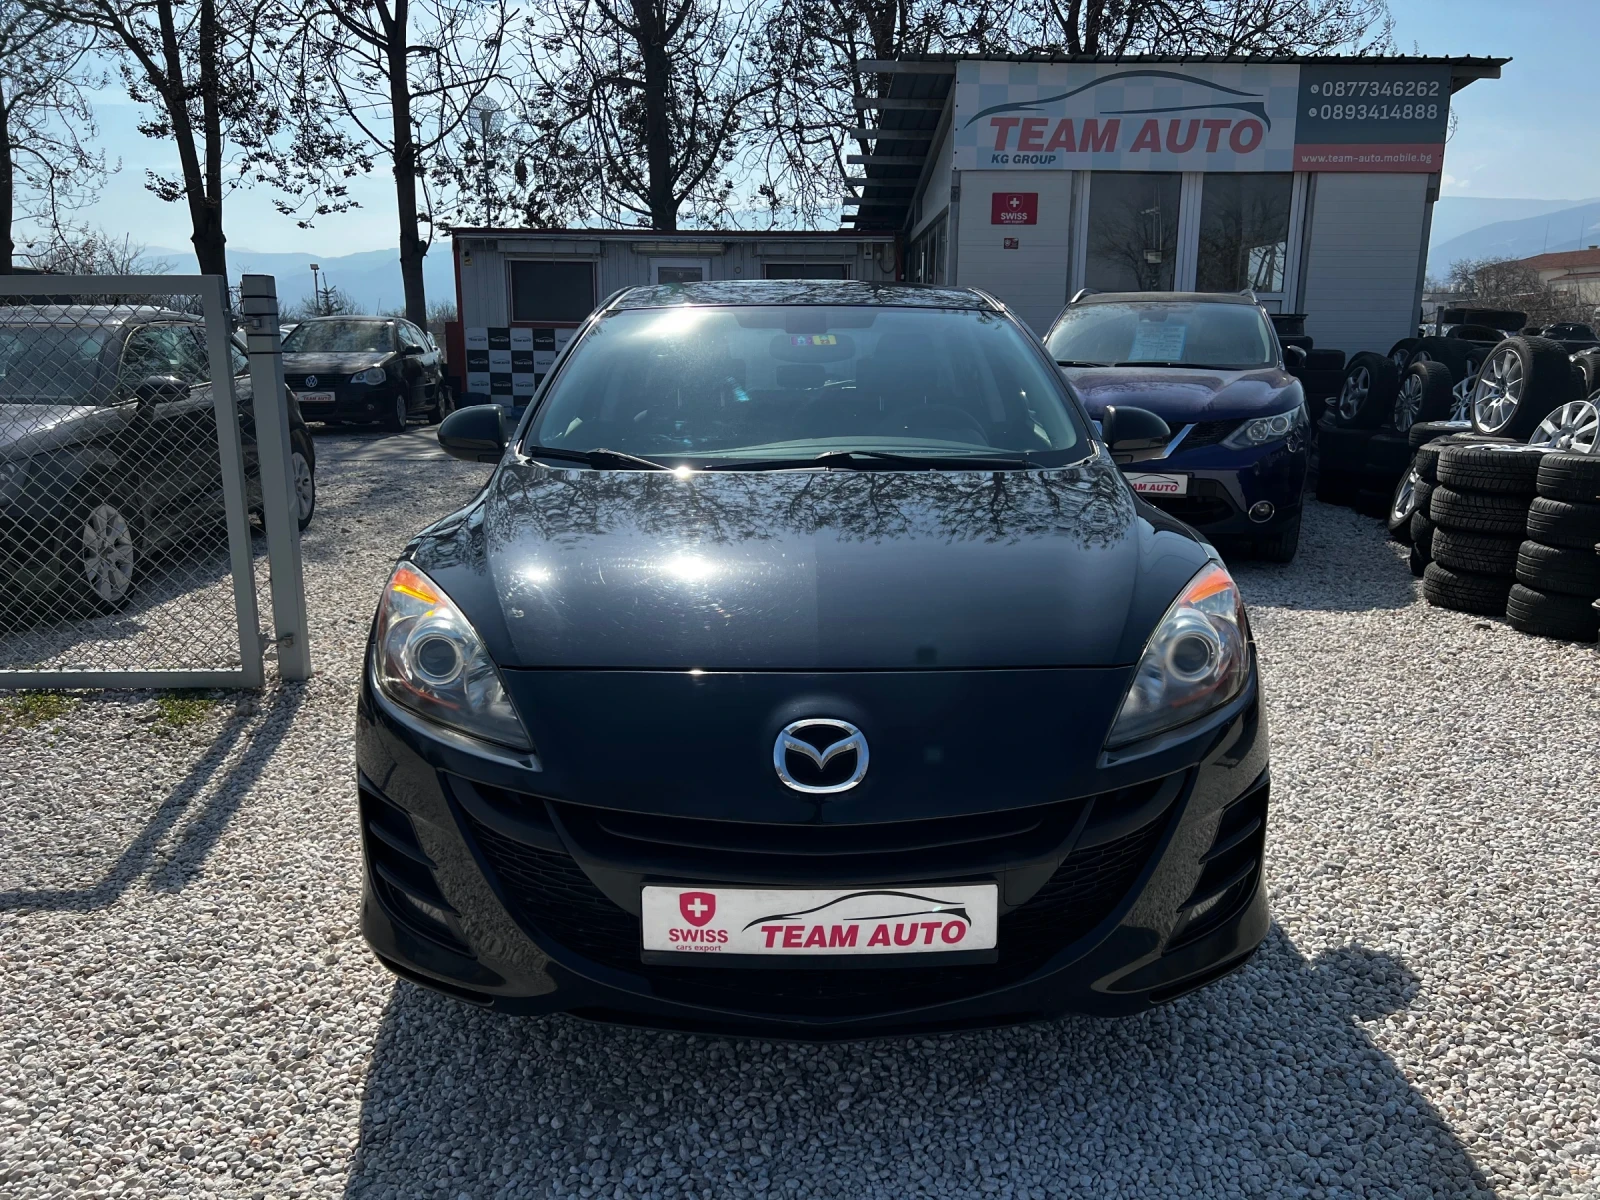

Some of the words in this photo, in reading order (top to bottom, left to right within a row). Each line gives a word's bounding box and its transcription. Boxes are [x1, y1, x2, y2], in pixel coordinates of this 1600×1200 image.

[1322, 81, 1440, 97] 0877346262
[1320, 104, 1438, 120] 0893414888
[989, 117, 1121, 153] TEAM
[1129, 117, 1264, 154] AUTO
[991, 153, 1010, 164] KG
[1012, 154, 1056, 165] GROUP
[1301, 152, 1432, 164] www.team-auto.mobile.bg
[1149, 484, 1178, 492] AUTO
[668, 928, 729, 943] SWISS
[761, 924, 859, 948] TEAM
[867, 920, 967, 947] AUTO
[694, 944, 722, 952] export
